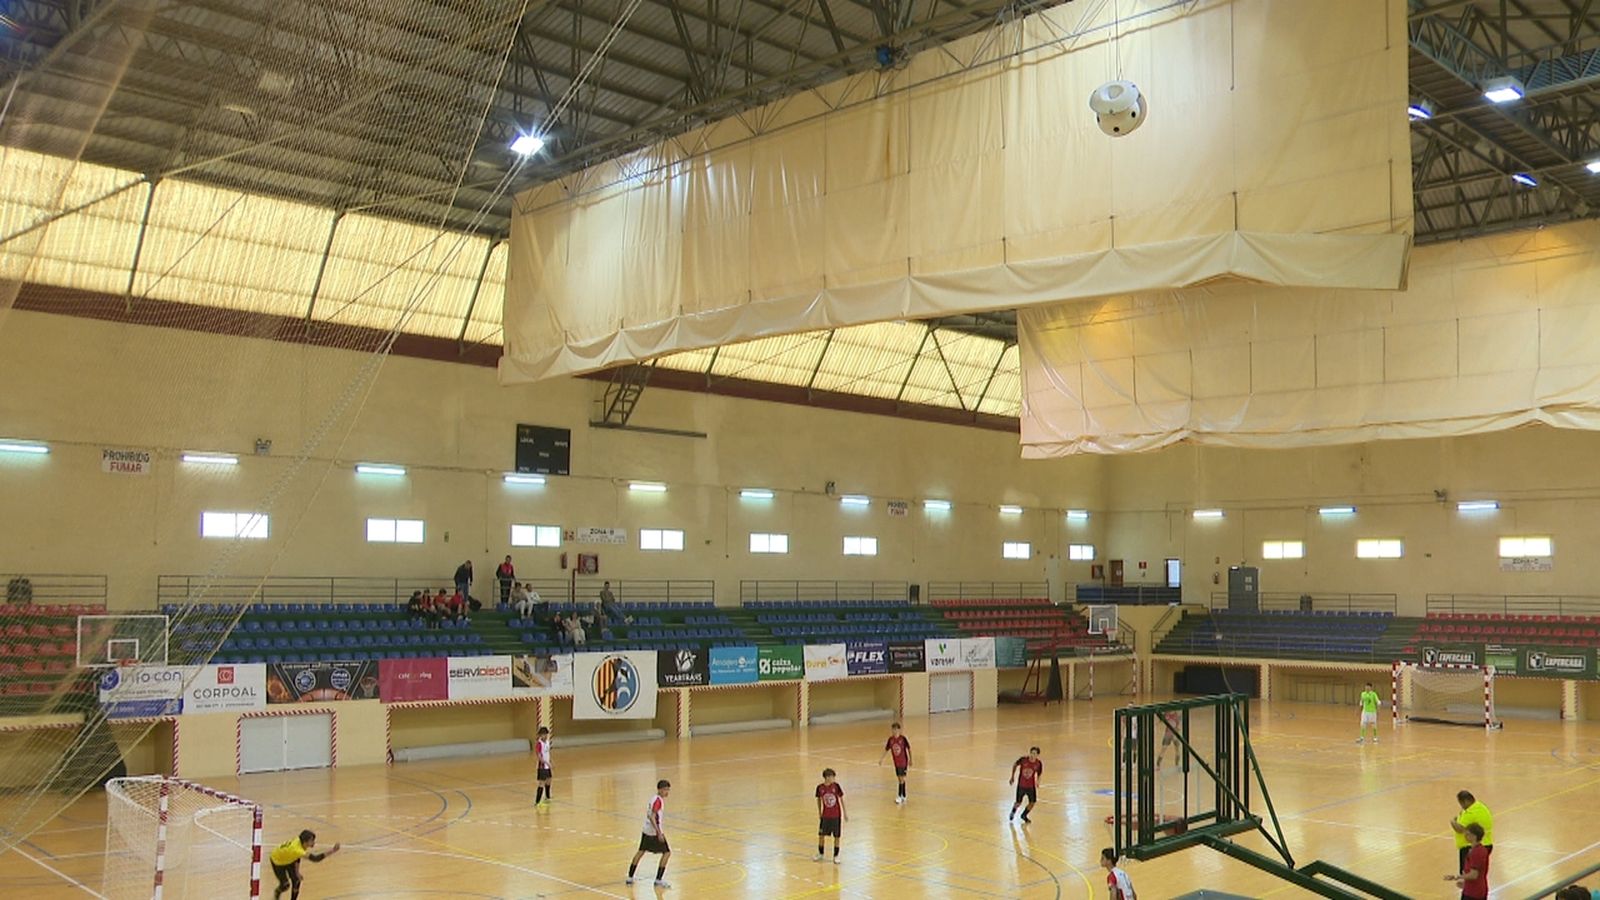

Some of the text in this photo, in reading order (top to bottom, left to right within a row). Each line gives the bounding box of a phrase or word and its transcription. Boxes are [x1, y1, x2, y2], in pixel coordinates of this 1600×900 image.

[103, 449, 150, 463] PROHIBIDO
[110, 461, 142, 472] FUMAR
[855, 650, 885, 663] FLEX
[772, 664, 801, 674] popular
[193, 687, 256, 699] CORPOAL
